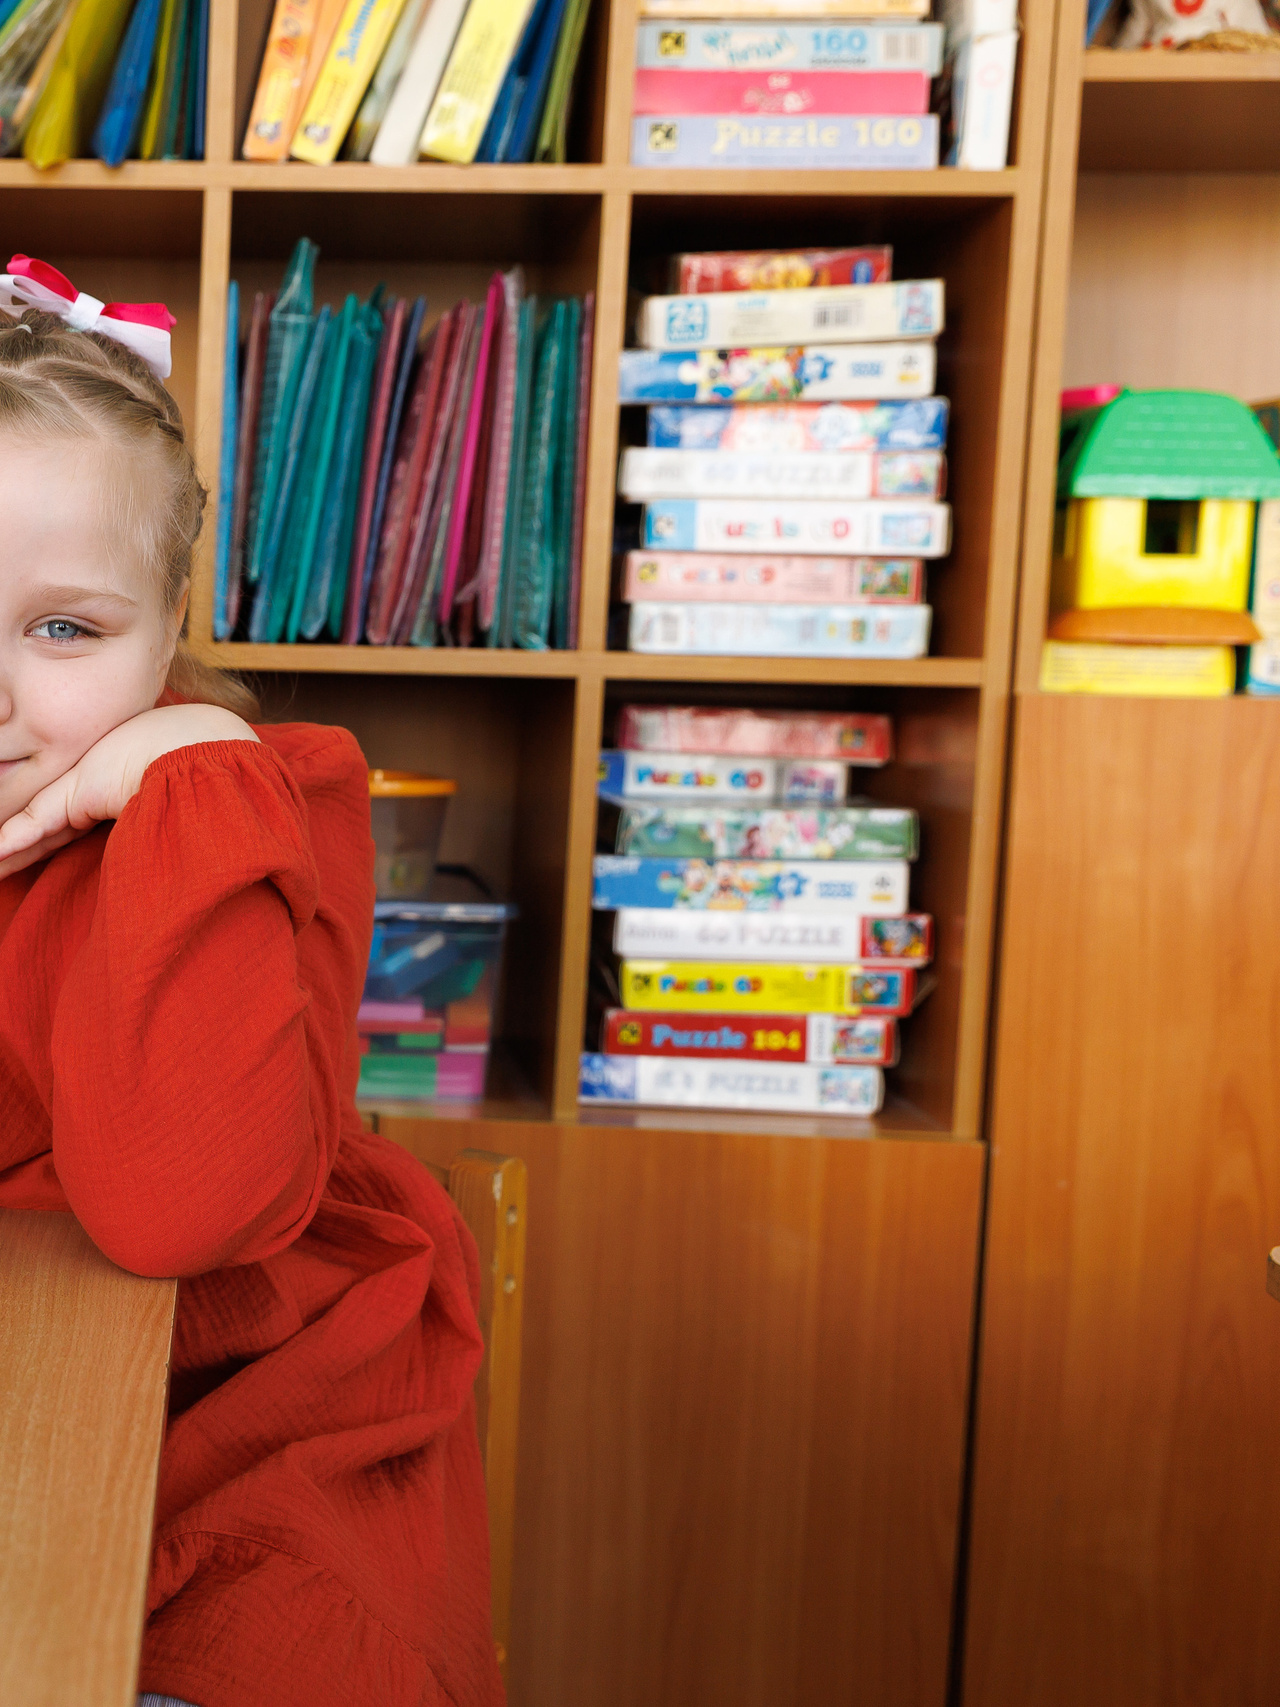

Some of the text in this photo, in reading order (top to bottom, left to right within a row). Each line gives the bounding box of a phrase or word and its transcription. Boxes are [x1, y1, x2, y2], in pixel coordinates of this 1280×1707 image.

[810, 28, 868, 54] 160
[710, 118, 922, 154] Puzzle 160
[651, 1023, 803, 1052] Puzzle 104
